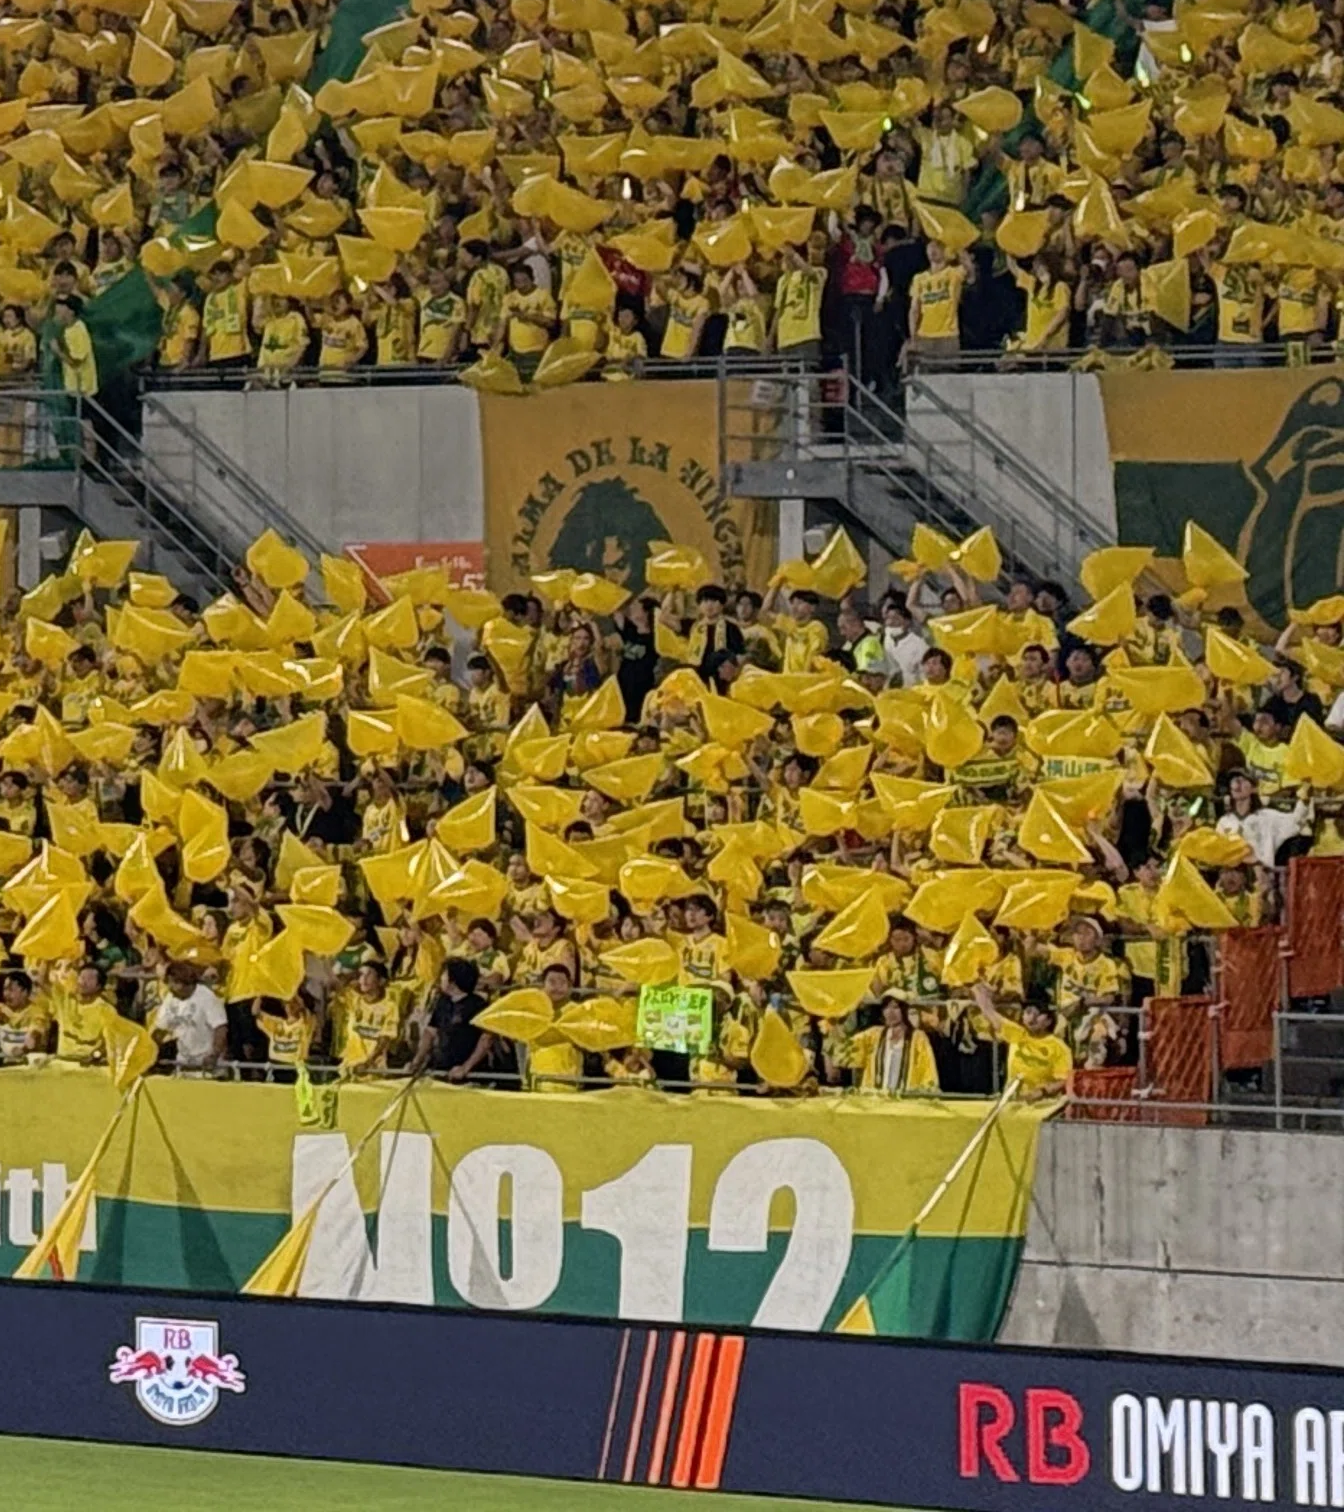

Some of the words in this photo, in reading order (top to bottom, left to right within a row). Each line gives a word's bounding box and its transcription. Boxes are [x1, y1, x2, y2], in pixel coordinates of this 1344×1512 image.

[566, 437, 616, 478] DE
[627, 436, 672, 473] LA
[164, 1328, 192, 1350] RB
[959, 1383, 1091, 1485] RB
[1111, 1392, 1276, 1502] OMIYA
